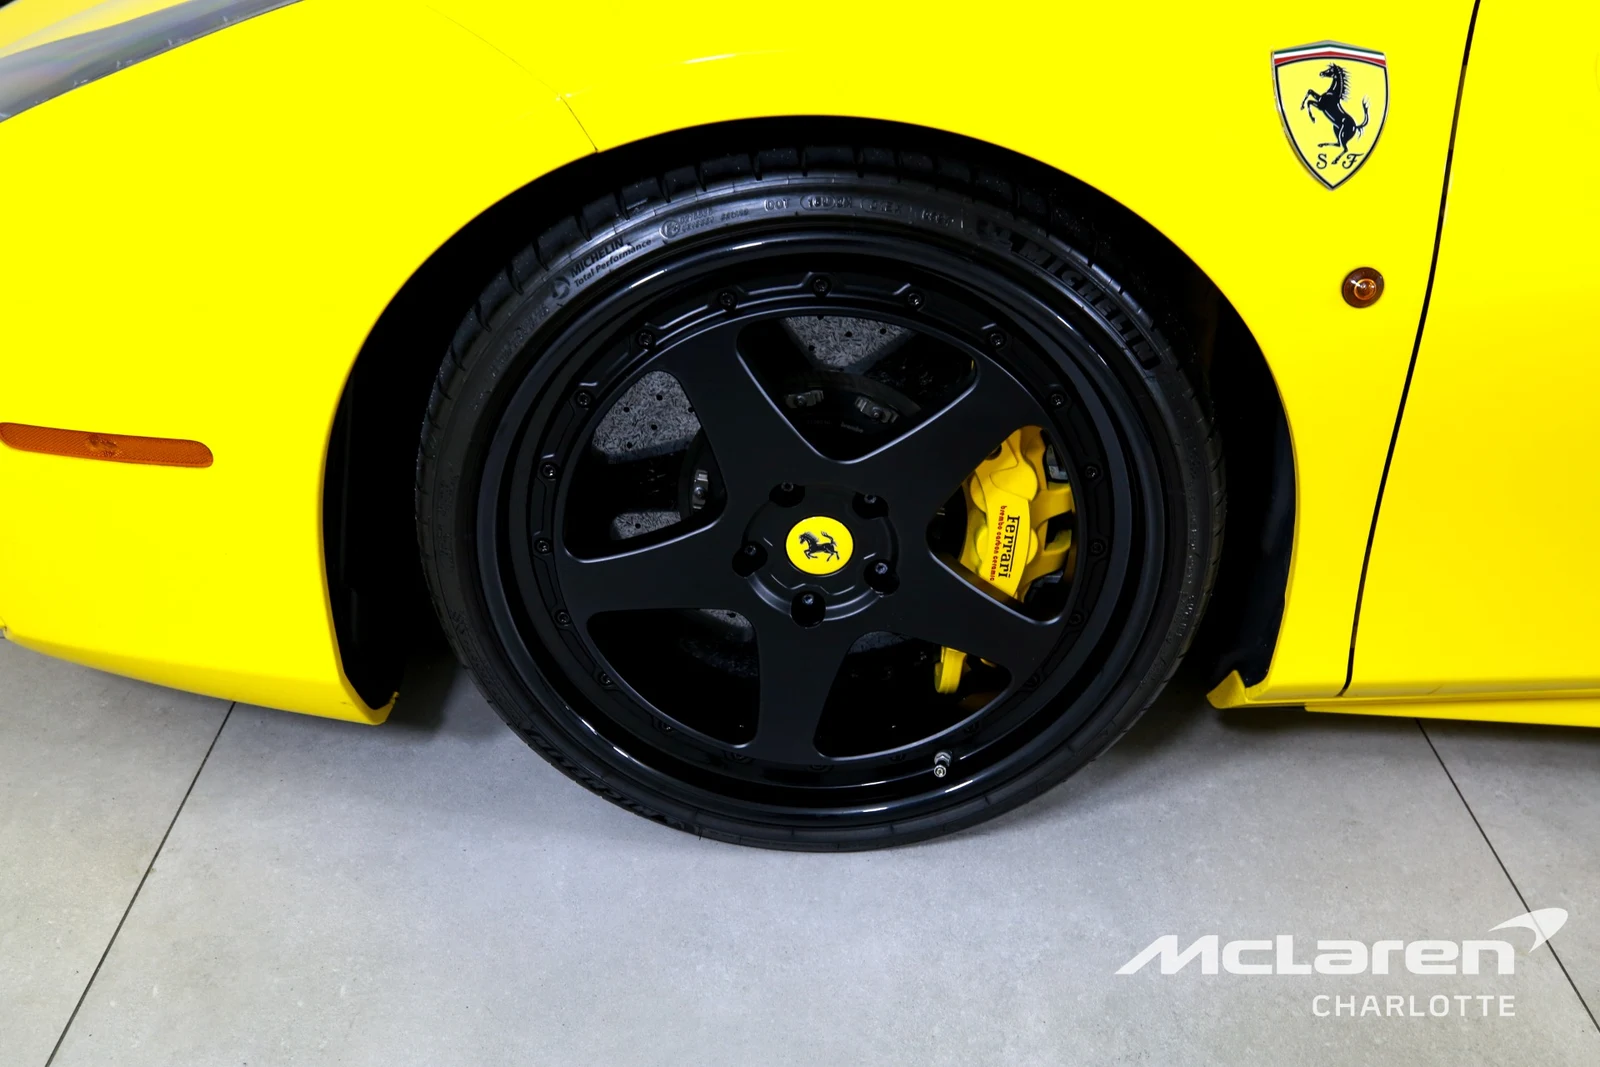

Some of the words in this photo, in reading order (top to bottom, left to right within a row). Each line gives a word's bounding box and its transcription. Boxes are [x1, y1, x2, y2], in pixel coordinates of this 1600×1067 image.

[569, 237, 625, 278] MICHELIN
[574, 270, 596, 288] Total
[595, 238, 652, 273] Performance
[1018, 238, 1159, 367] MICHELIN
[997, 505, 1008, 530] brembo
[993, 531, 1002, 554] carbon
[998, 515, 1020, 578] Ferrari
[989, 556, 998, 581] ceramic
